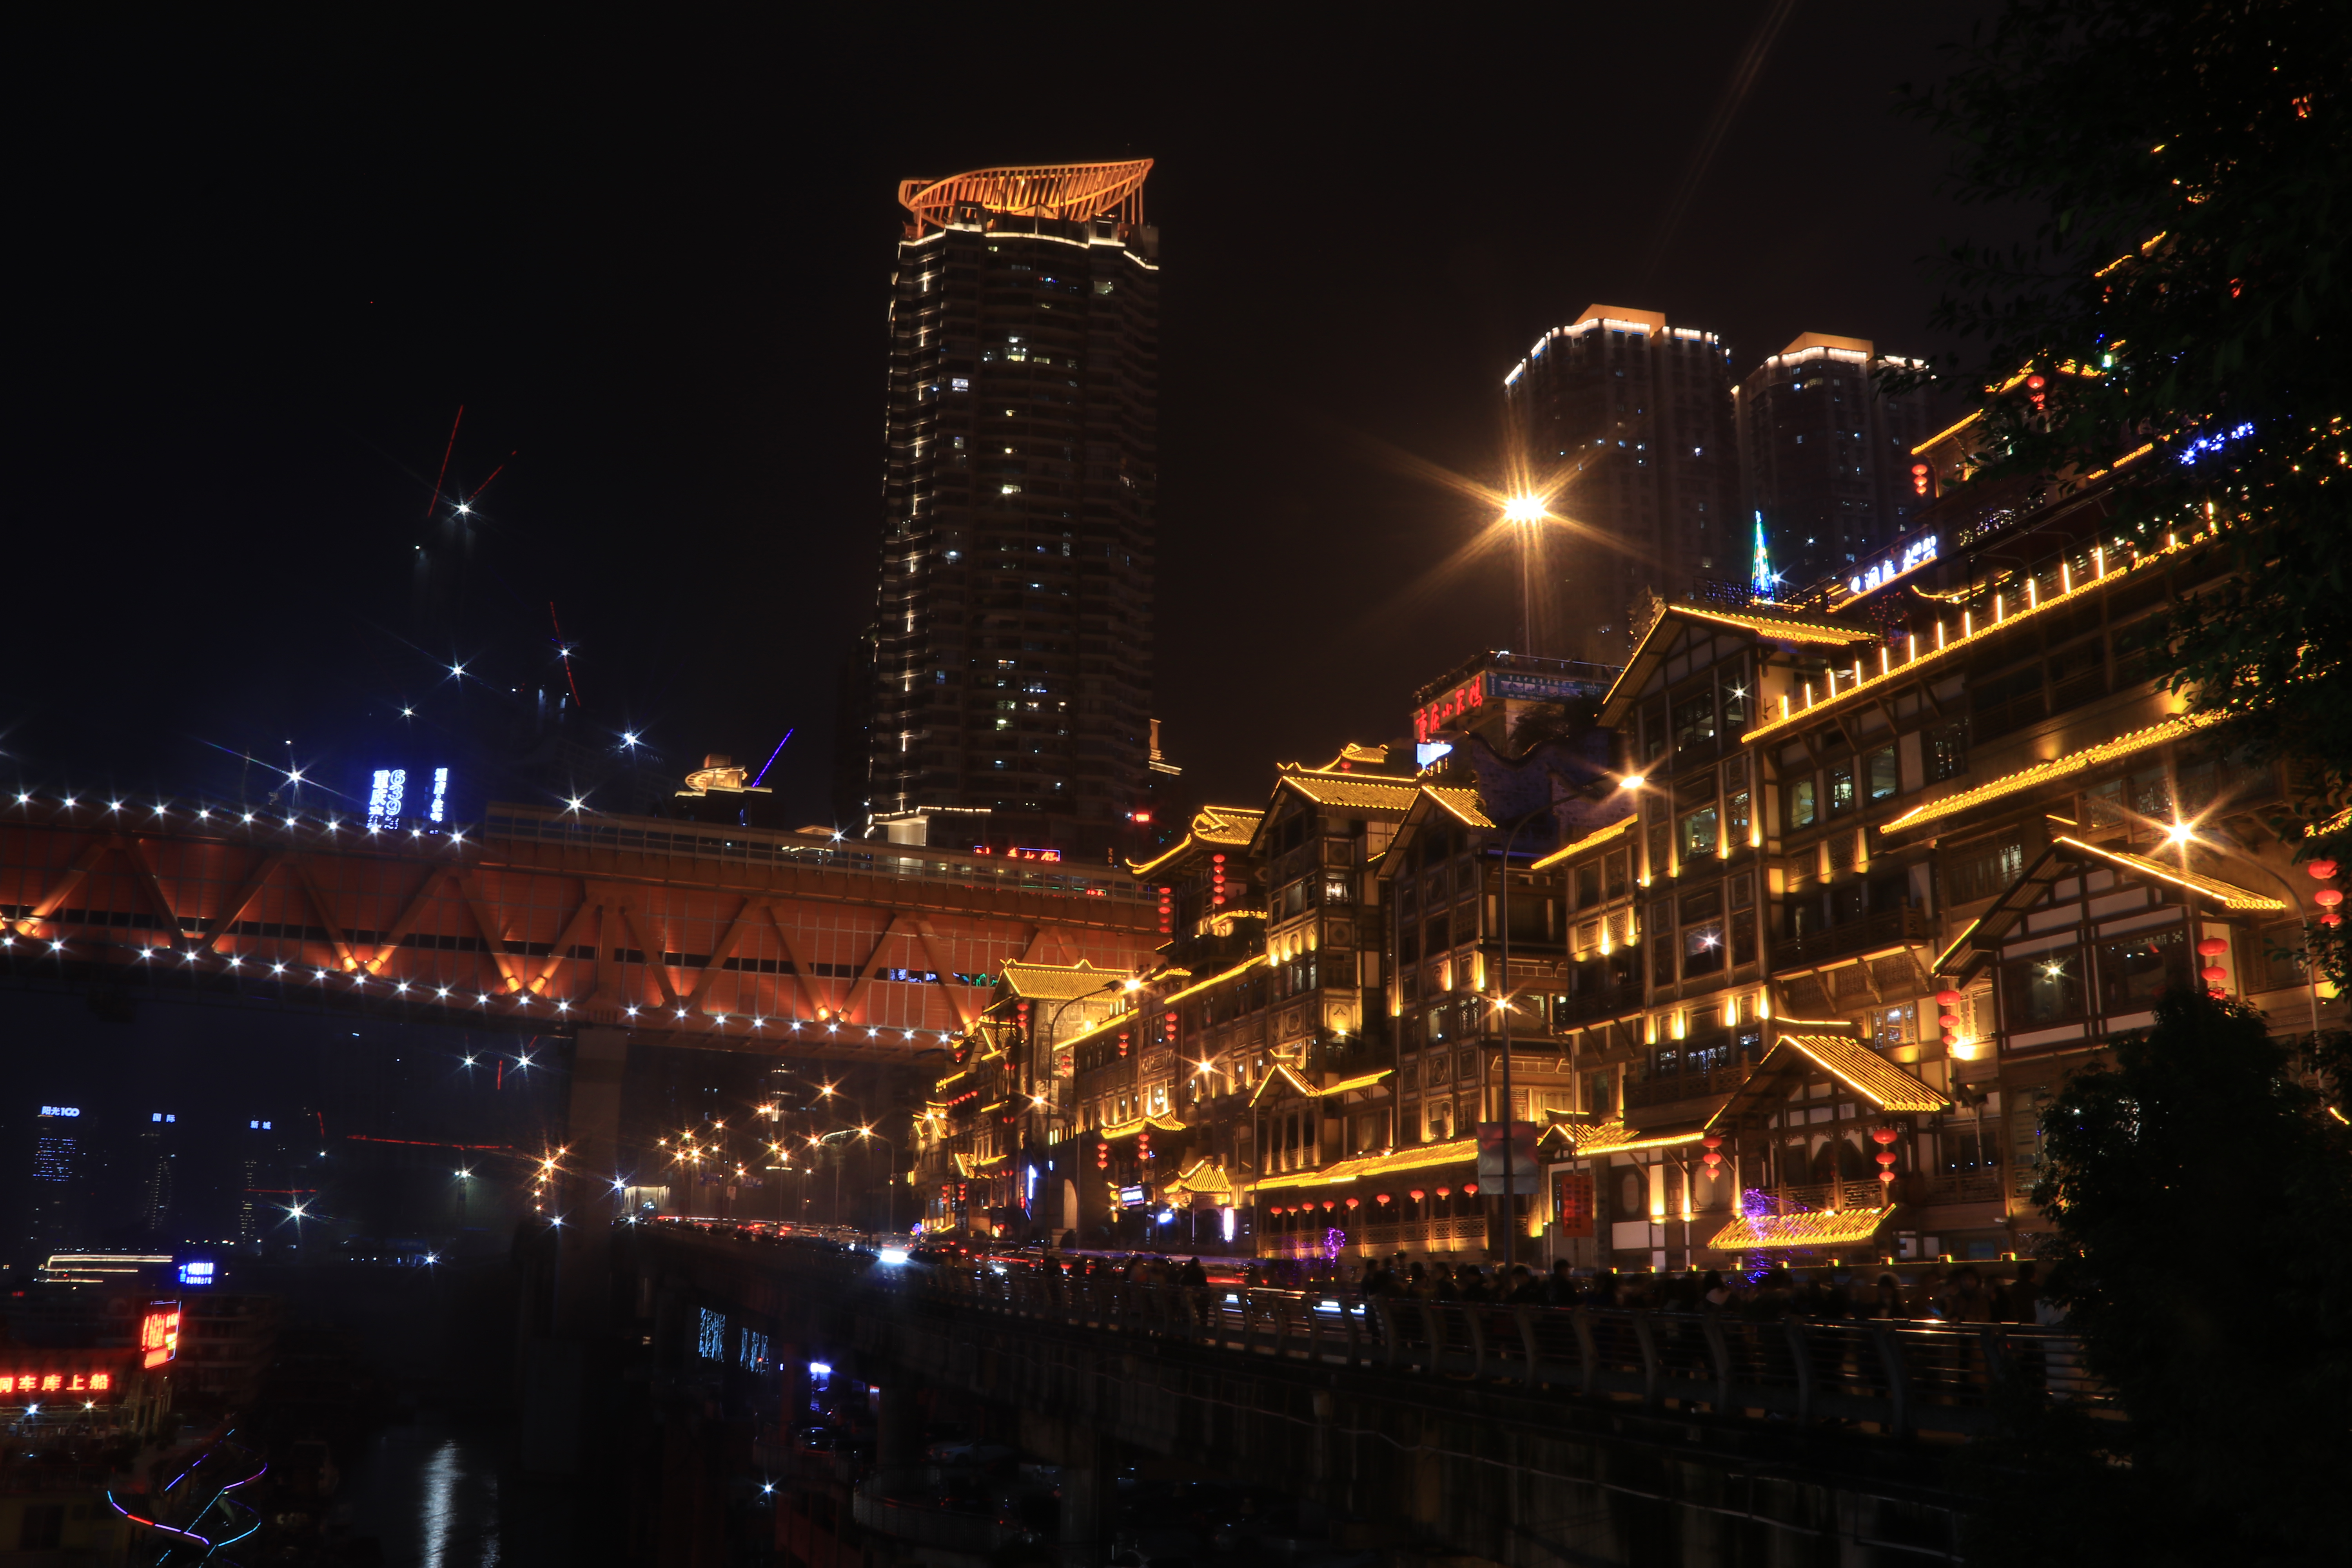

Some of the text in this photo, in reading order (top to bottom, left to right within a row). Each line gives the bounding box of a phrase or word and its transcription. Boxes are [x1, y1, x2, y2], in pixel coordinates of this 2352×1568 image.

[386, 769, 406, 816] 639
[41, 1105, 80, 1117] 阳光100
[152, 1113, 176, 1123] 国际
